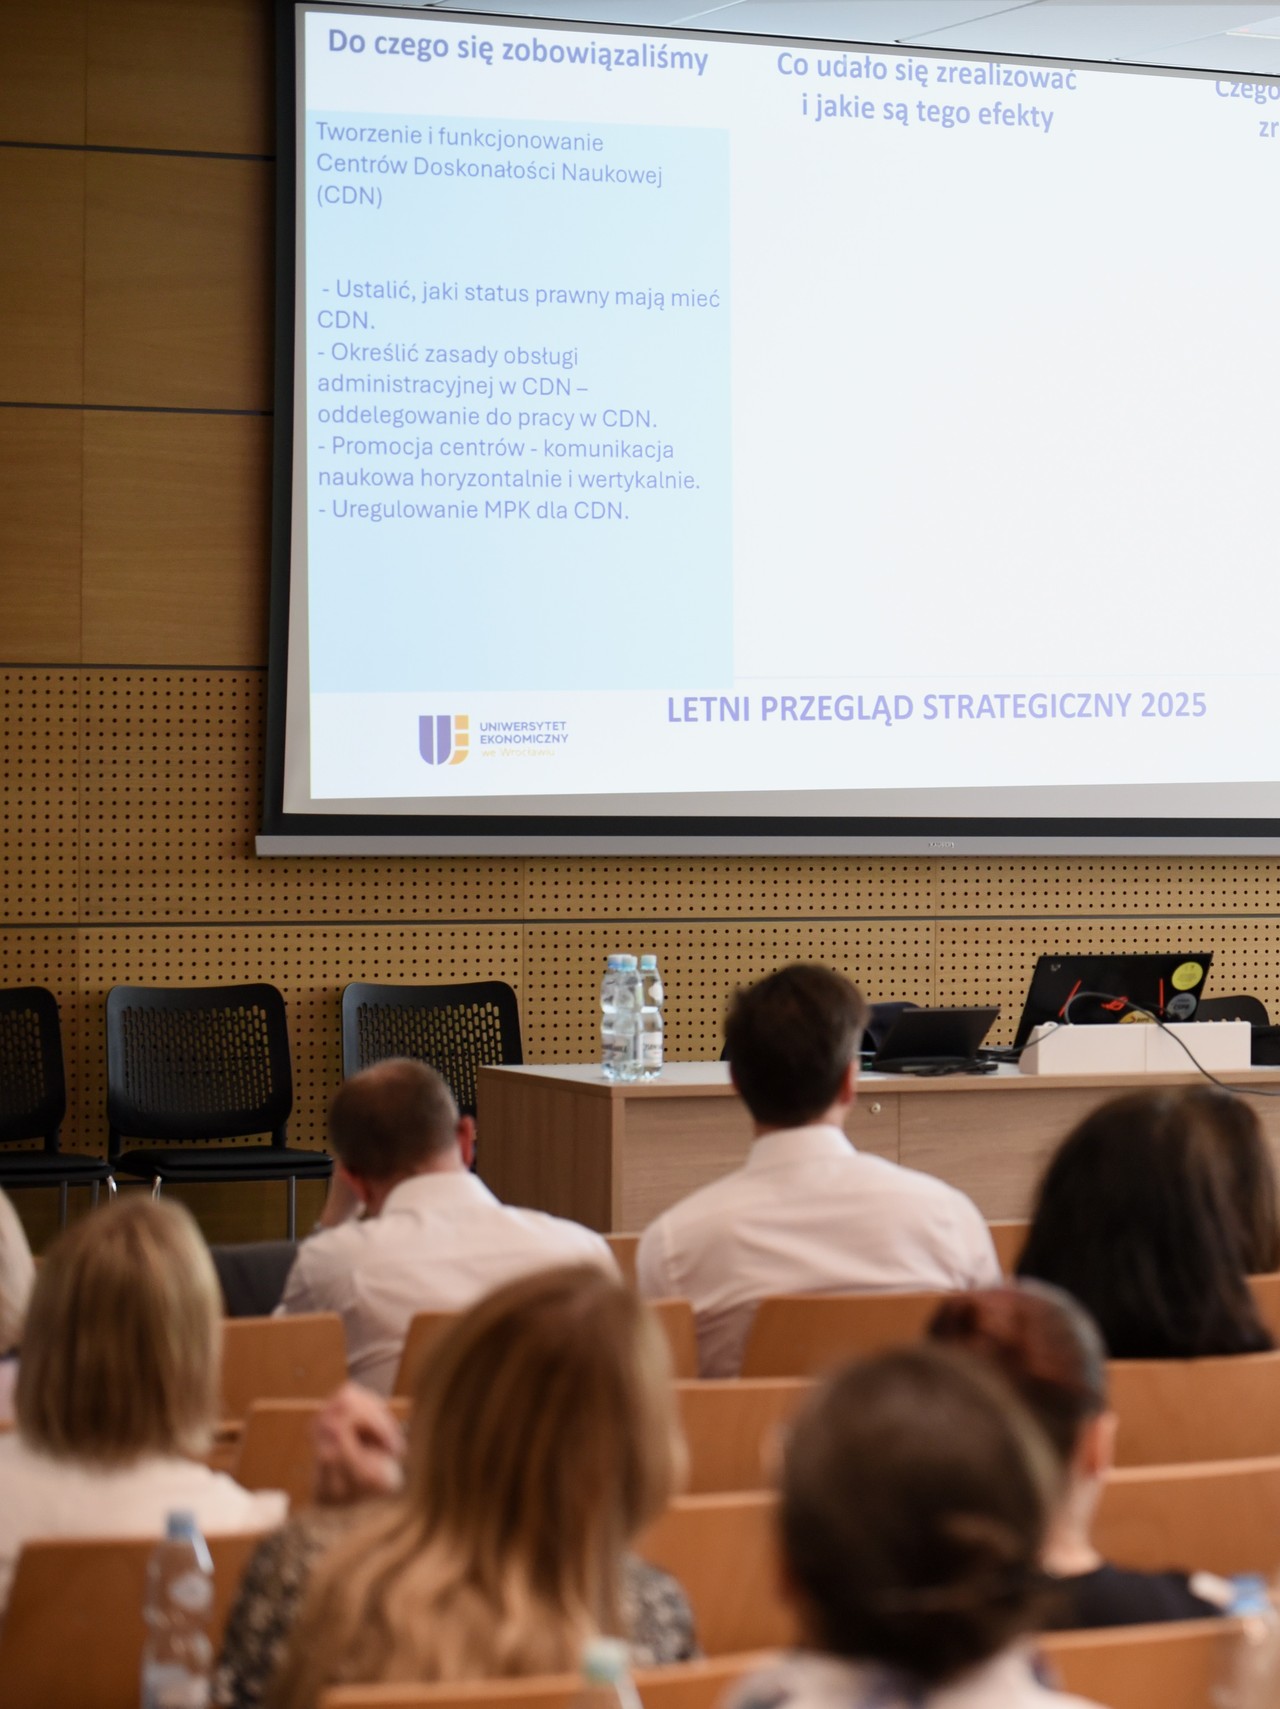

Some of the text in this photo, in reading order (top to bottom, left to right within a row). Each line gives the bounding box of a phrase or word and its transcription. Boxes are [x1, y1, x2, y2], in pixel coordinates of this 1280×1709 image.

[328, 29, 709, 76] Do czego się zobowiązaliśmy
[777, 51, 1077, 90] Co udało się zrealizować
[802, 92, 1054, 133] i jakie są tego efekty
[316, 121, 604, 152] Tworzenie i funkcjonowanie
[316, 154, 663, 188] Centrów Doskonałości Naukowej
[316, 185, 383, 209] (CDN)
[336, 279, 417, 303] Ustalić,
[421, 282, 460, 303] jaki
[464, 284, 529, 303] status
[535, 288, 610, 308] prawny
[615, 288, 665, 311] mają
[670, 289, 720, 308] mieć
[317, 311, 375, 330] CDN.
[331, 342, 419, 363] Określić
[424, 346, 499, 368] zasady
[503, 347, 579, 369] obsługi
[317, 375, 494, 398] administracyjnej
[499, 381, 517, 395] w
[521, 378, 571, 396] CDN
[317, 406, 658, 430] oddelegowanie do pracy w CDN.
[332, 437, 433, 460] Promocja
[439, 438, 525, 457] centrów
[543, 439, 675, 461] komunikacja
[318, 469, 701, 492] naukowa horyzontalnie i wertykalnie.
[332, 500, 479, 522] Uregulowanie
[484, 501, 531, 519] MPK
[536, 501, 568, 520] dla
[574, 501, 629, 521] CDN.
[667, 691, 1207, 726] LETNI PRZEGLĄD STRATEGICZNY 2025
[479, 720, 567, 732] UNIWERSYTET
[479, 734, 569, 744] EKONOMICZNY
[481, 749, 496, 757] we
